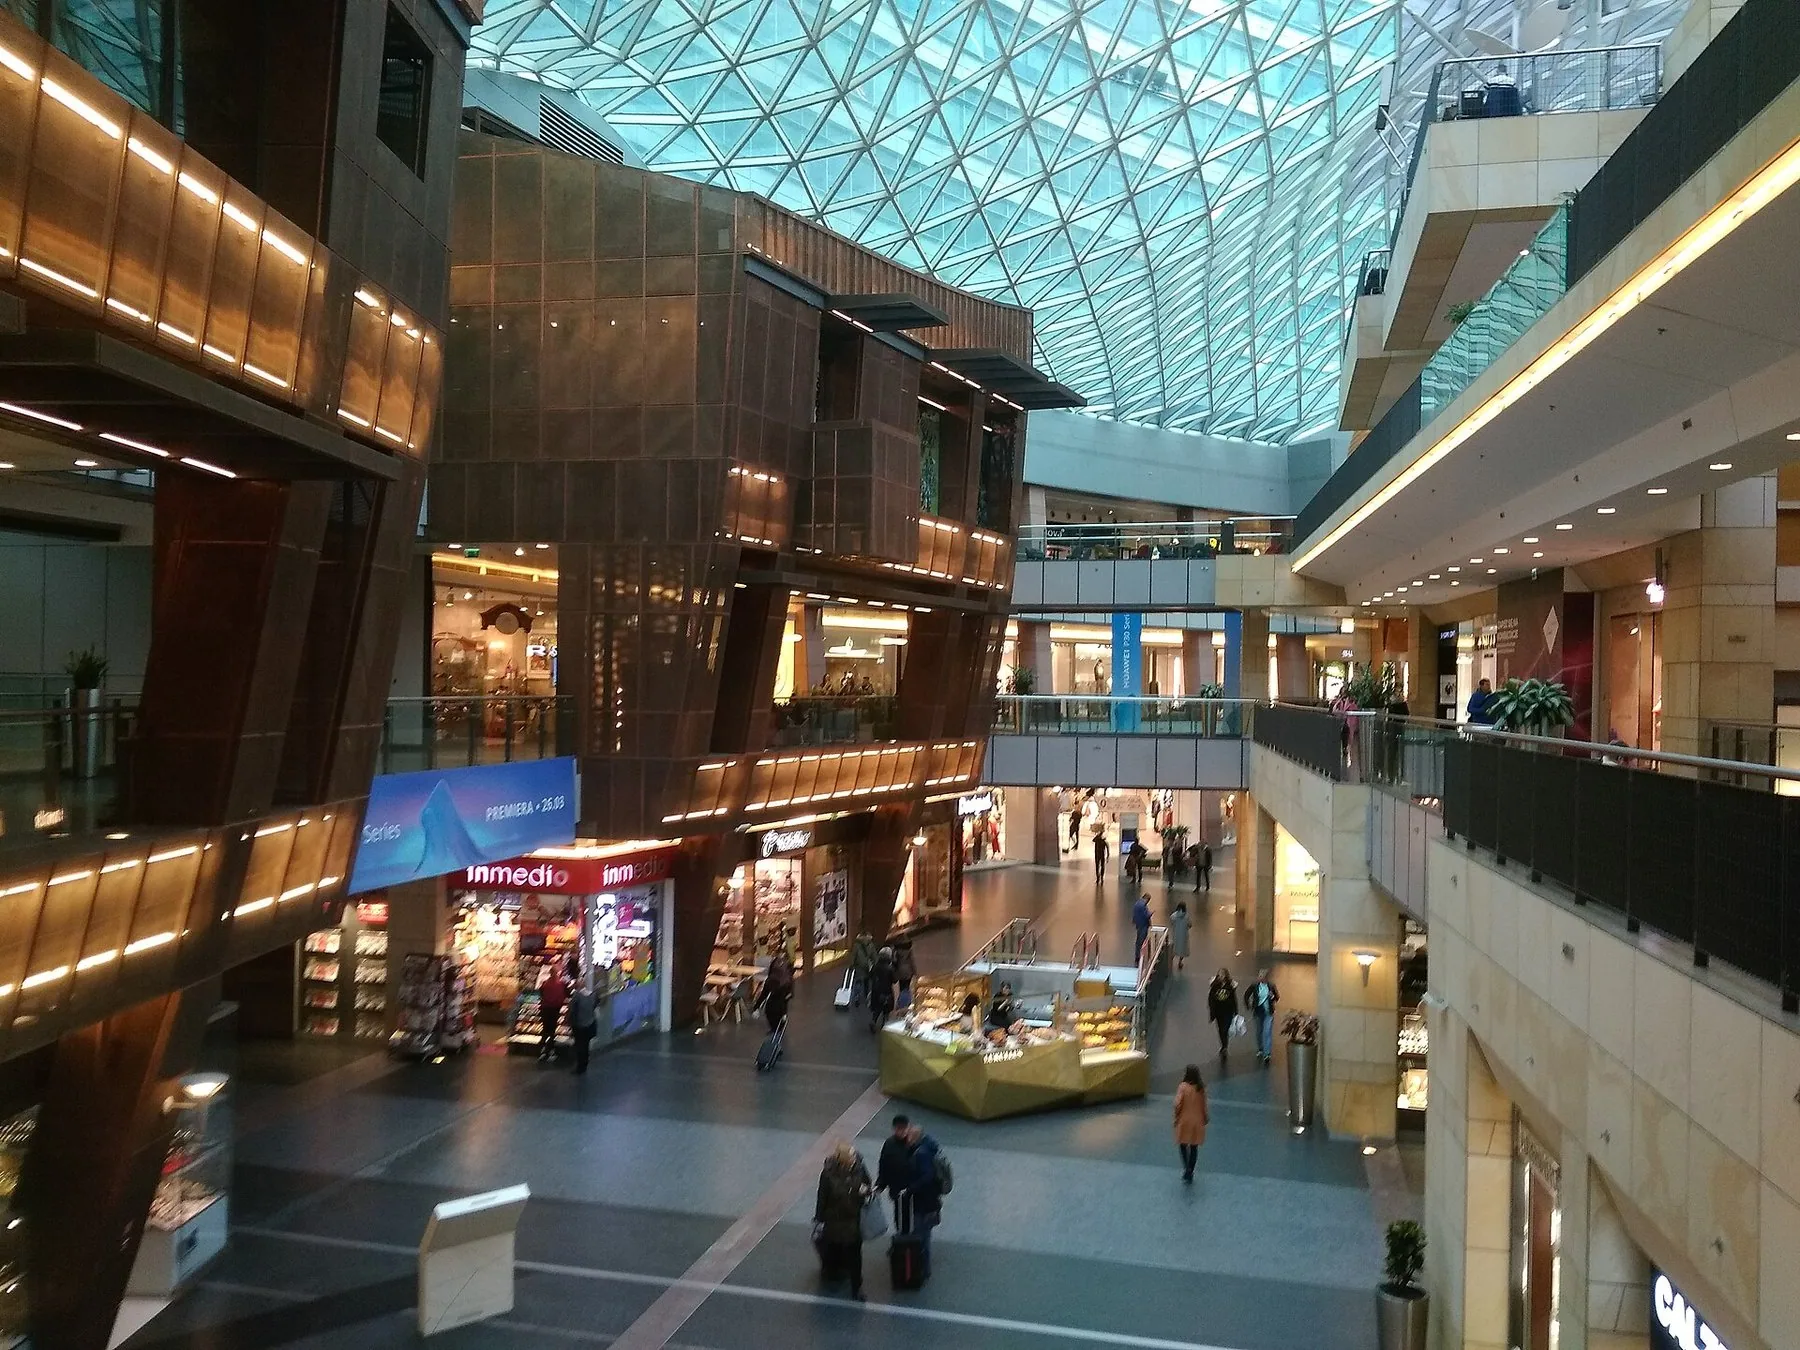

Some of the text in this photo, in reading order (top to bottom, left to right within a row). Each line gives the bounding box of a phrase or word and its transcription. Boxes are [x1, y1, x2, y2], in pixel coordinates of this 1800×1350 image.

[485, 795, 565, 822] PREMIERA 26.03
[362, 821, 401, 845] Series
[466, 864, 569, 887] inmedio
[603, 856, 666, 887] inmedio
